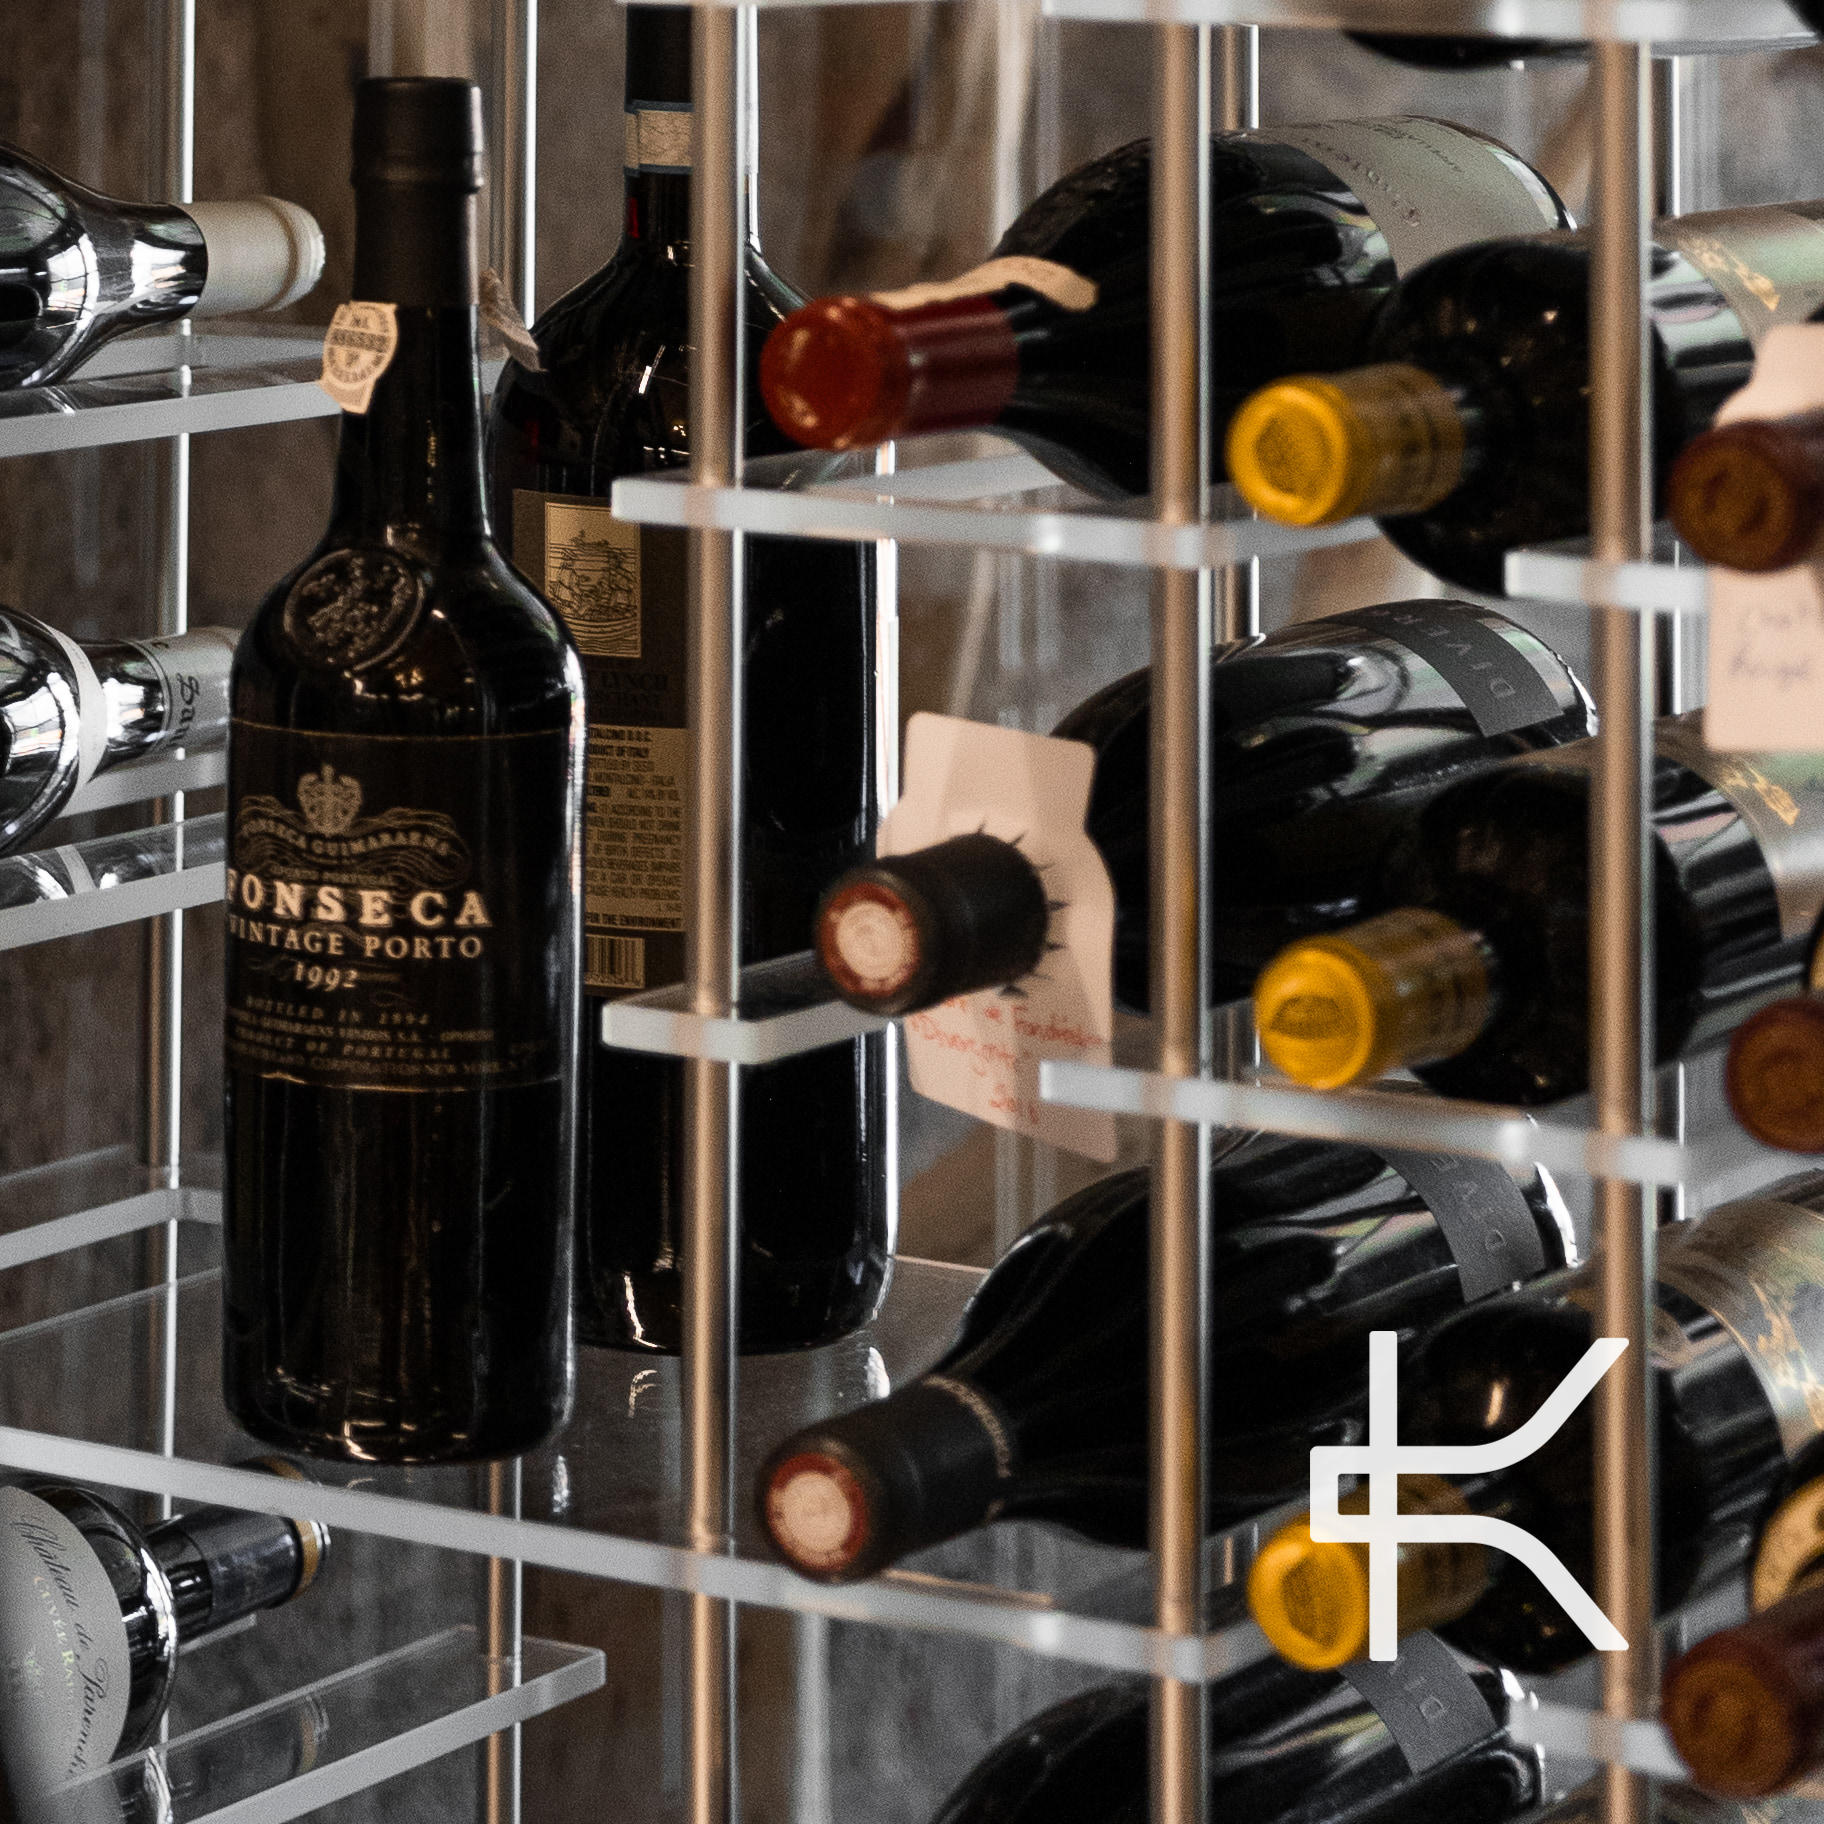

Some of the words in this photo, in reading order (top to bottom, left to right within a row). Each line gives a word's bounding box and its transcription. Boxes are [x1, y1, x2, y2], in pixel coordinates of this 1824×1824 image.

[364, 935, 483, 960] PORTO
[294, 962, 360, 991] 1992
[13, 1521, 80, 1610] Château
